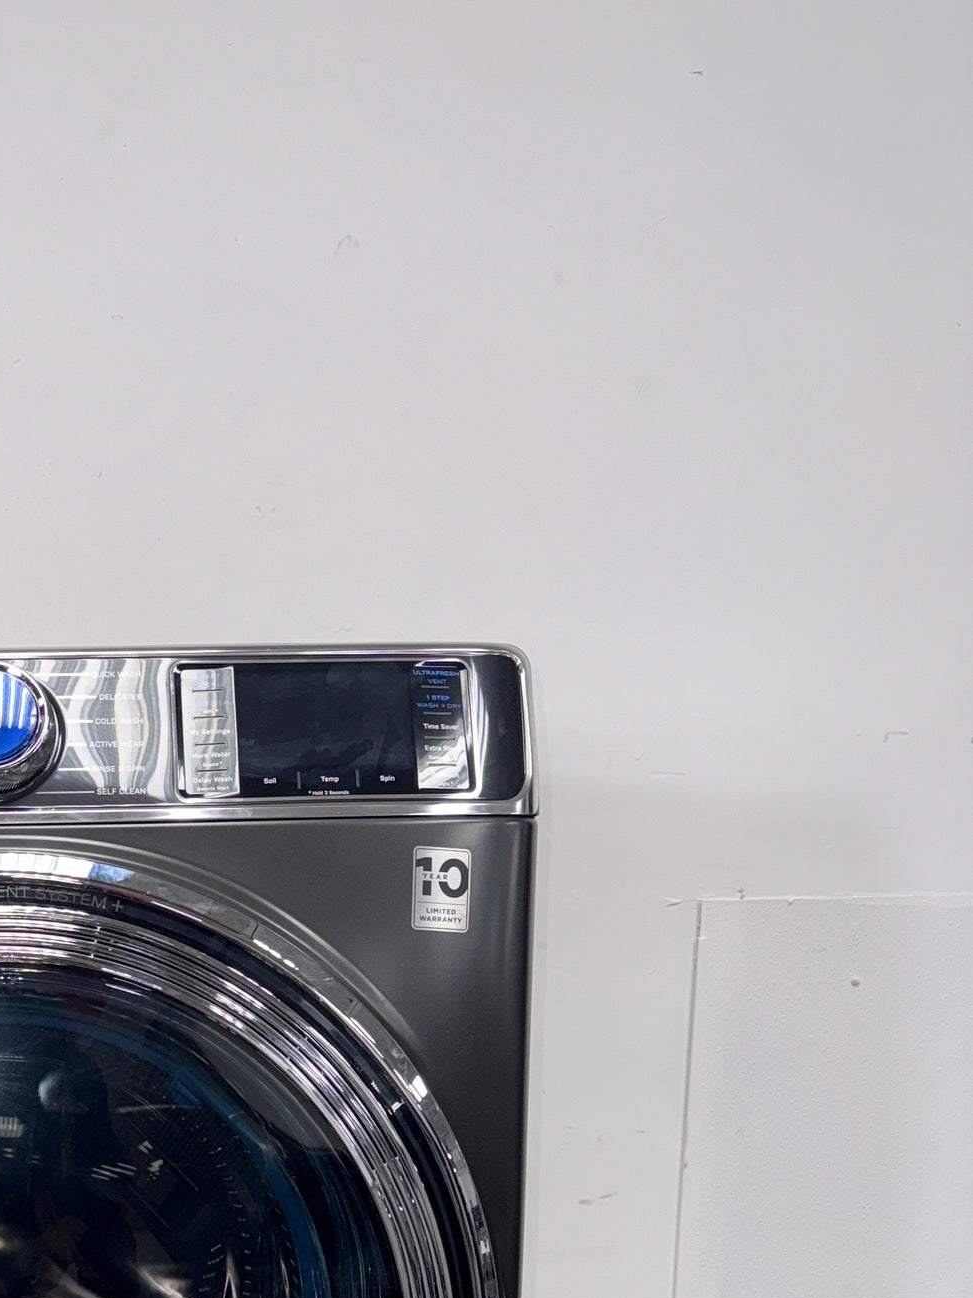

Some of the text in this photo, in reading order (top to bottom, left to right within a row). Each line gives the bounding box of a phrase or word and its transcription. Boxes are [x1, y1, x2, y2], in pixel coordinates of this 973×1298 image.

[413, 669, 459, 677] ULTRAFRESH
[99, 693, 142, 701] DELATES
[94, 717, 144, 725] COLD WASH
[201, 728, 230, 736] Settings
[211, 751, 232, 759] Water
[320, 775, 340, 783] Temp
[96, 787, 146, 796] SELF CLEAN
[416, 857, 469, 899] 10
[422, 872, 448, 880] YEAR
[34, 887, 107, 910] SYSTEM
[112, 900, 124, 912] +
[426, 907, 457, 915] LIMITED
[419, 915, 463, 924] WARRANTY
